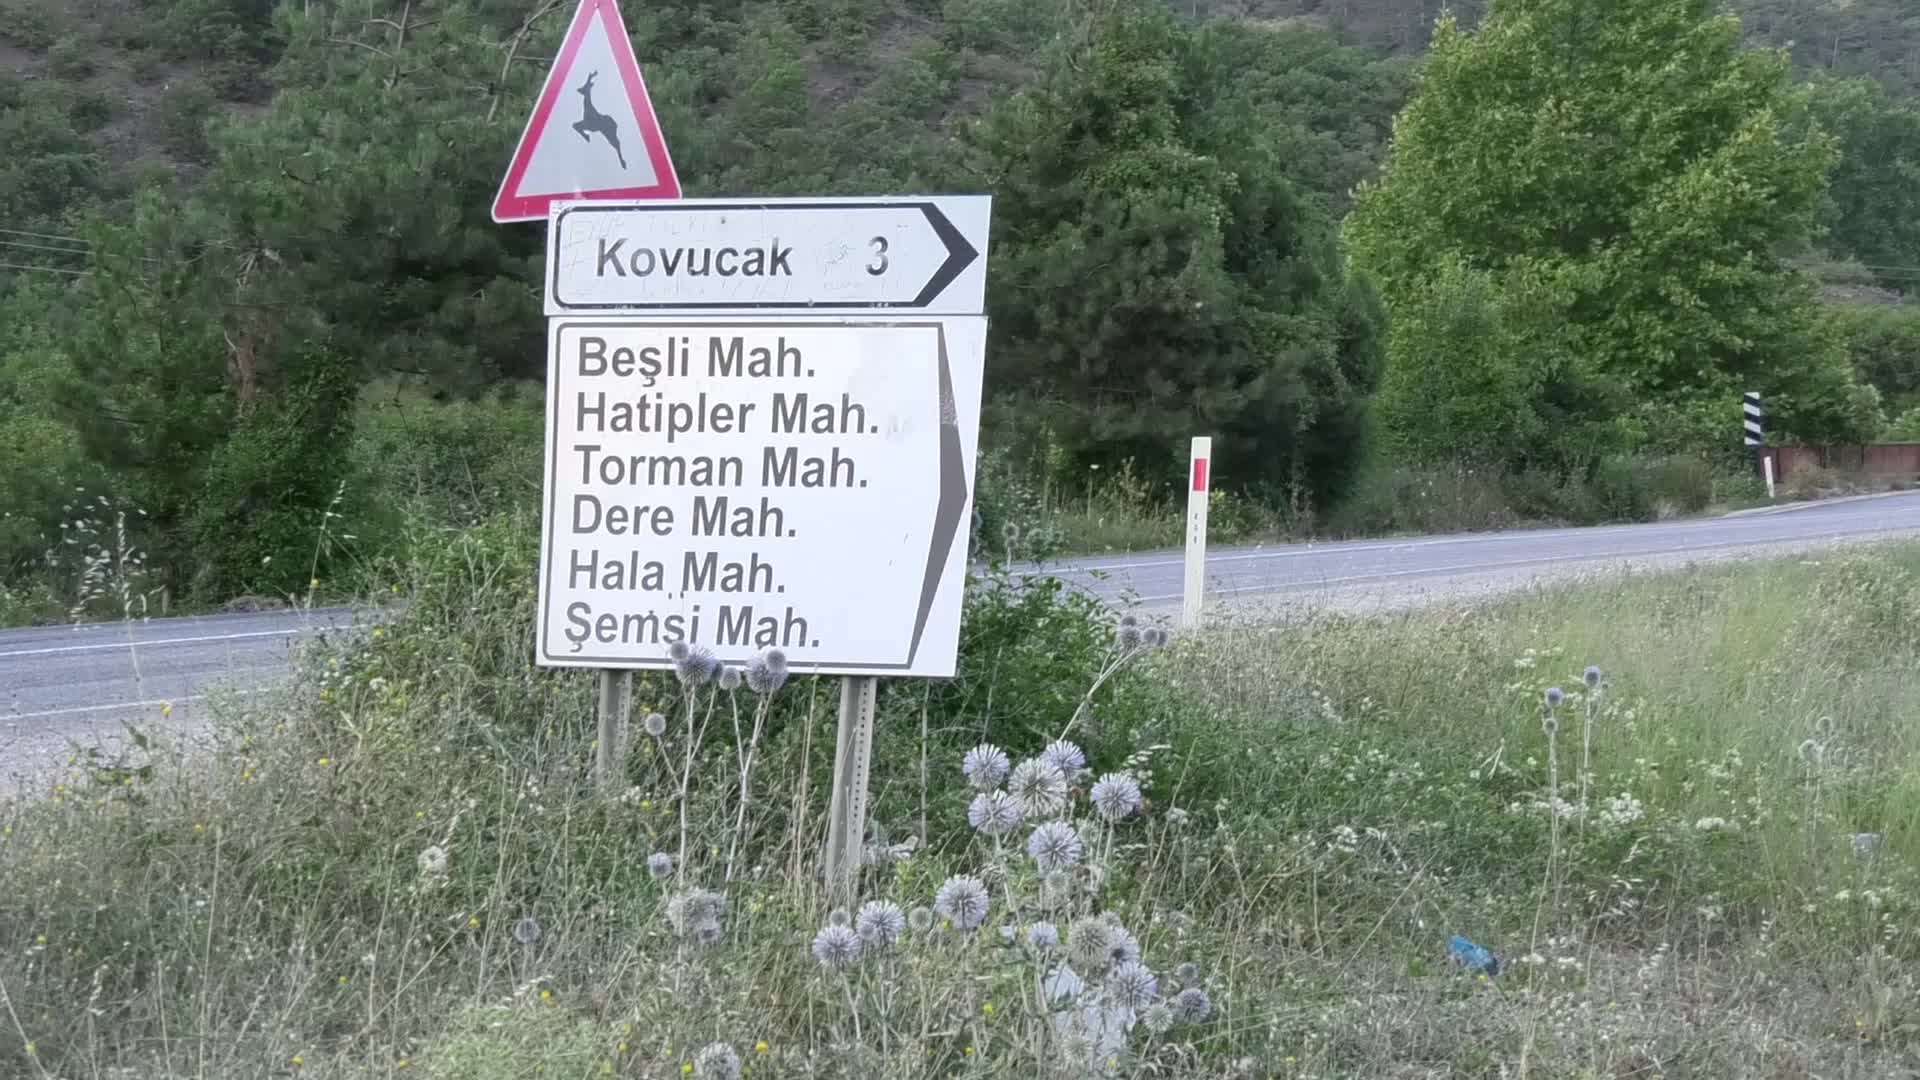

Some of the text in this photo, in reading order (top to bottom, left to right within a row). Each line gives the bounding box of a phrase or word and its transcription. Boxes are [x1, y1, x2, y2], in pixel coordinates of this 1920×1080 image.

[596, 235, 889, 277] Kovucak 3
[578, 336, 816, 387] Beşli Mah.
[575, 391, 880, 443] Hatipler Mah.
[573, 444, 869, 489] Torman Mah.
[572, 494, 797, 538] Dere Mah.
[568, 549, 786, 594] Hala Mah.
[564, 601, 820, 653] Şemsi Mah.
